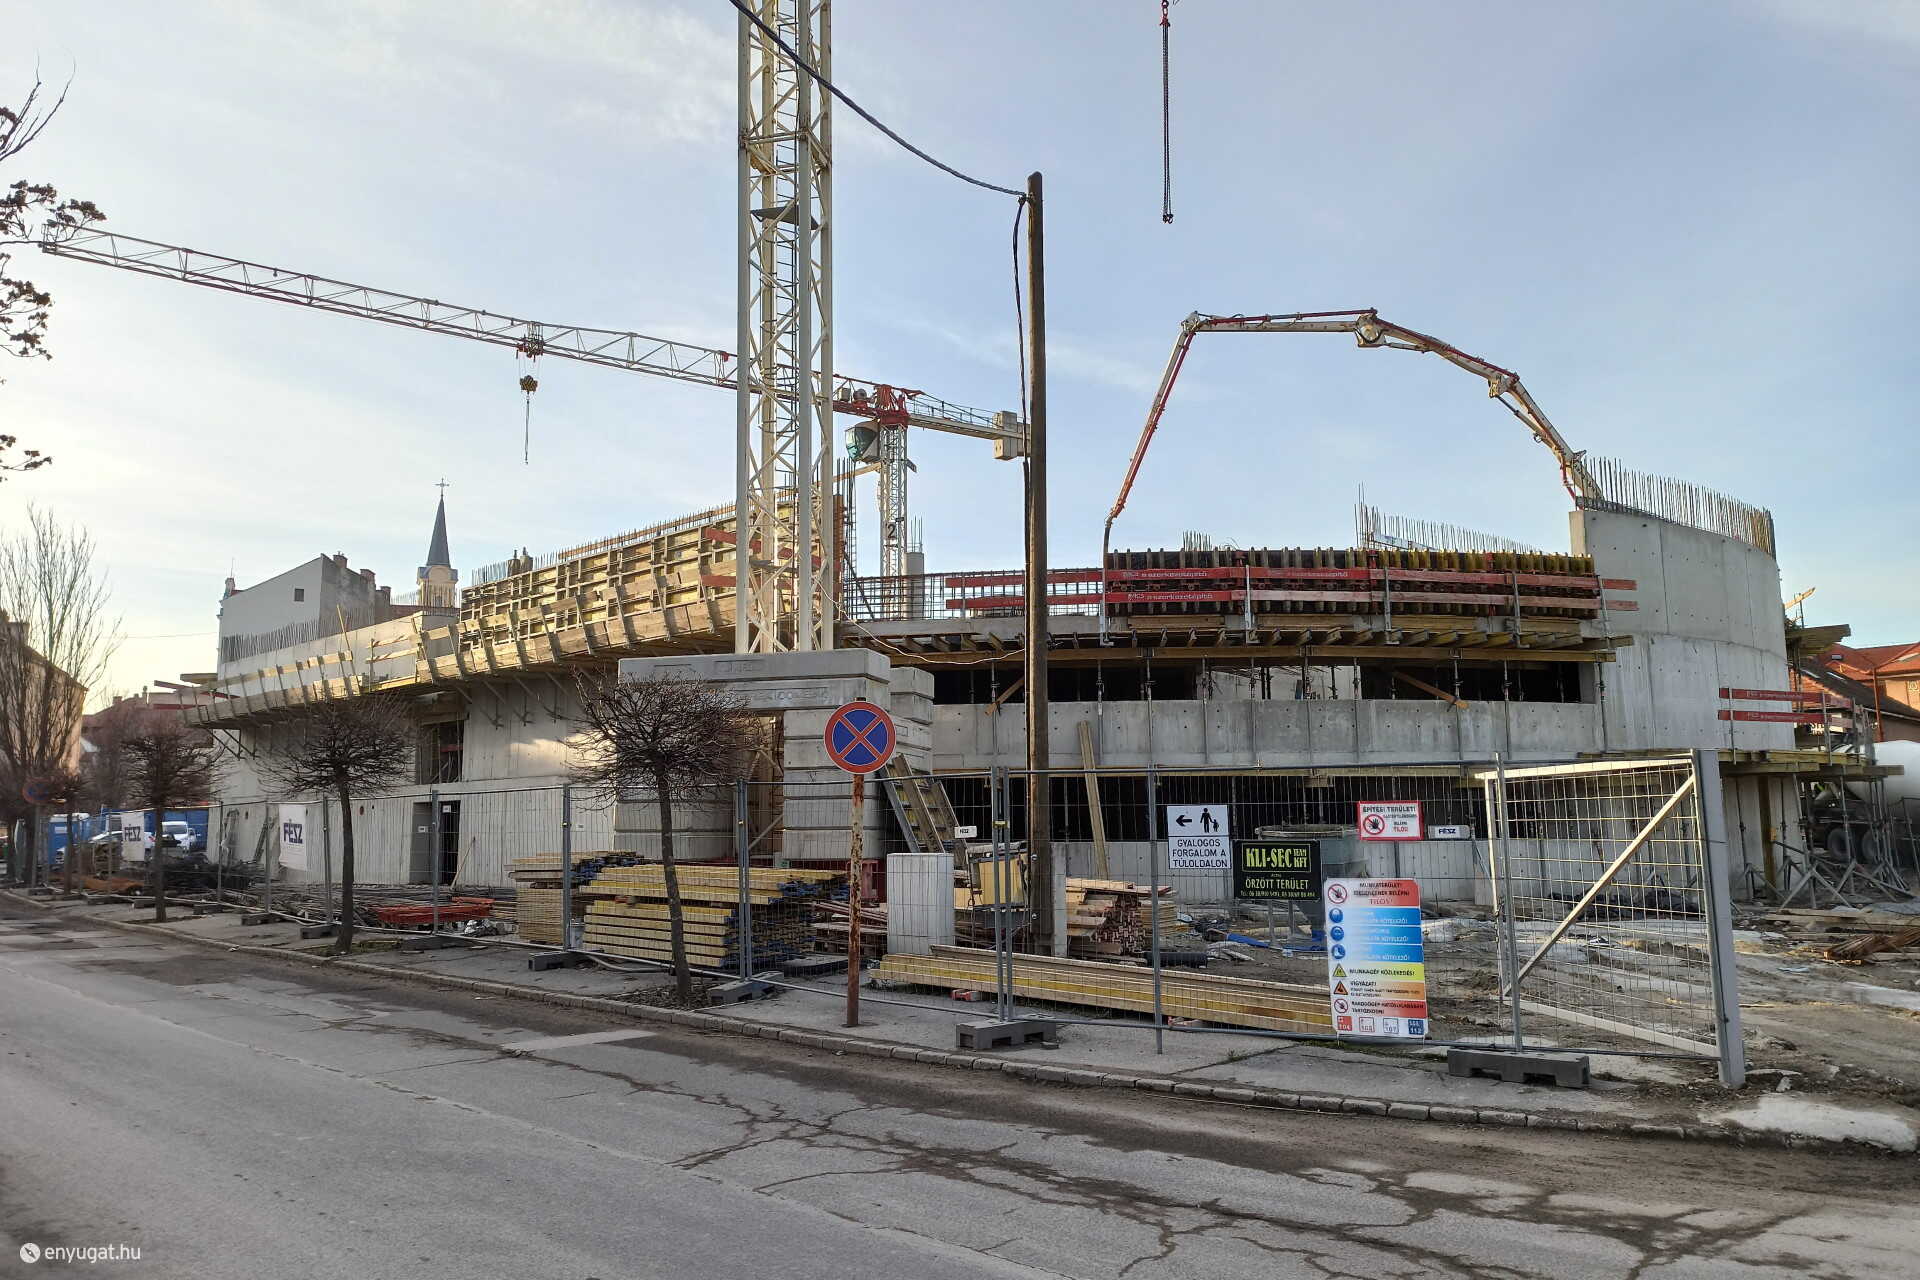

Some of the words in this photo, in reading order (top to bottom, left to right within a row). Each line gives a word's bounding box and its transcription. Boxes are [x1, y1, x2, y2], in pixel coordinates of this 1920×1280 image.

[887, 524, 896, 538] 2
[283, 818, 303, 844] FÉSZ
[1177, 839, 1221, 847] GYALOGOS
[1172, 848, 1217, 857] FORGALOM
[1220, 849, 1227, 857] A
[1246, 847, 1292, 868] KLI-SEC
[1172, 857, 1228, 868] TÚLOLDALON
[1293, 857, 1307, 868] KFT
[1275, 877, 1309, 889] TERÜLET
